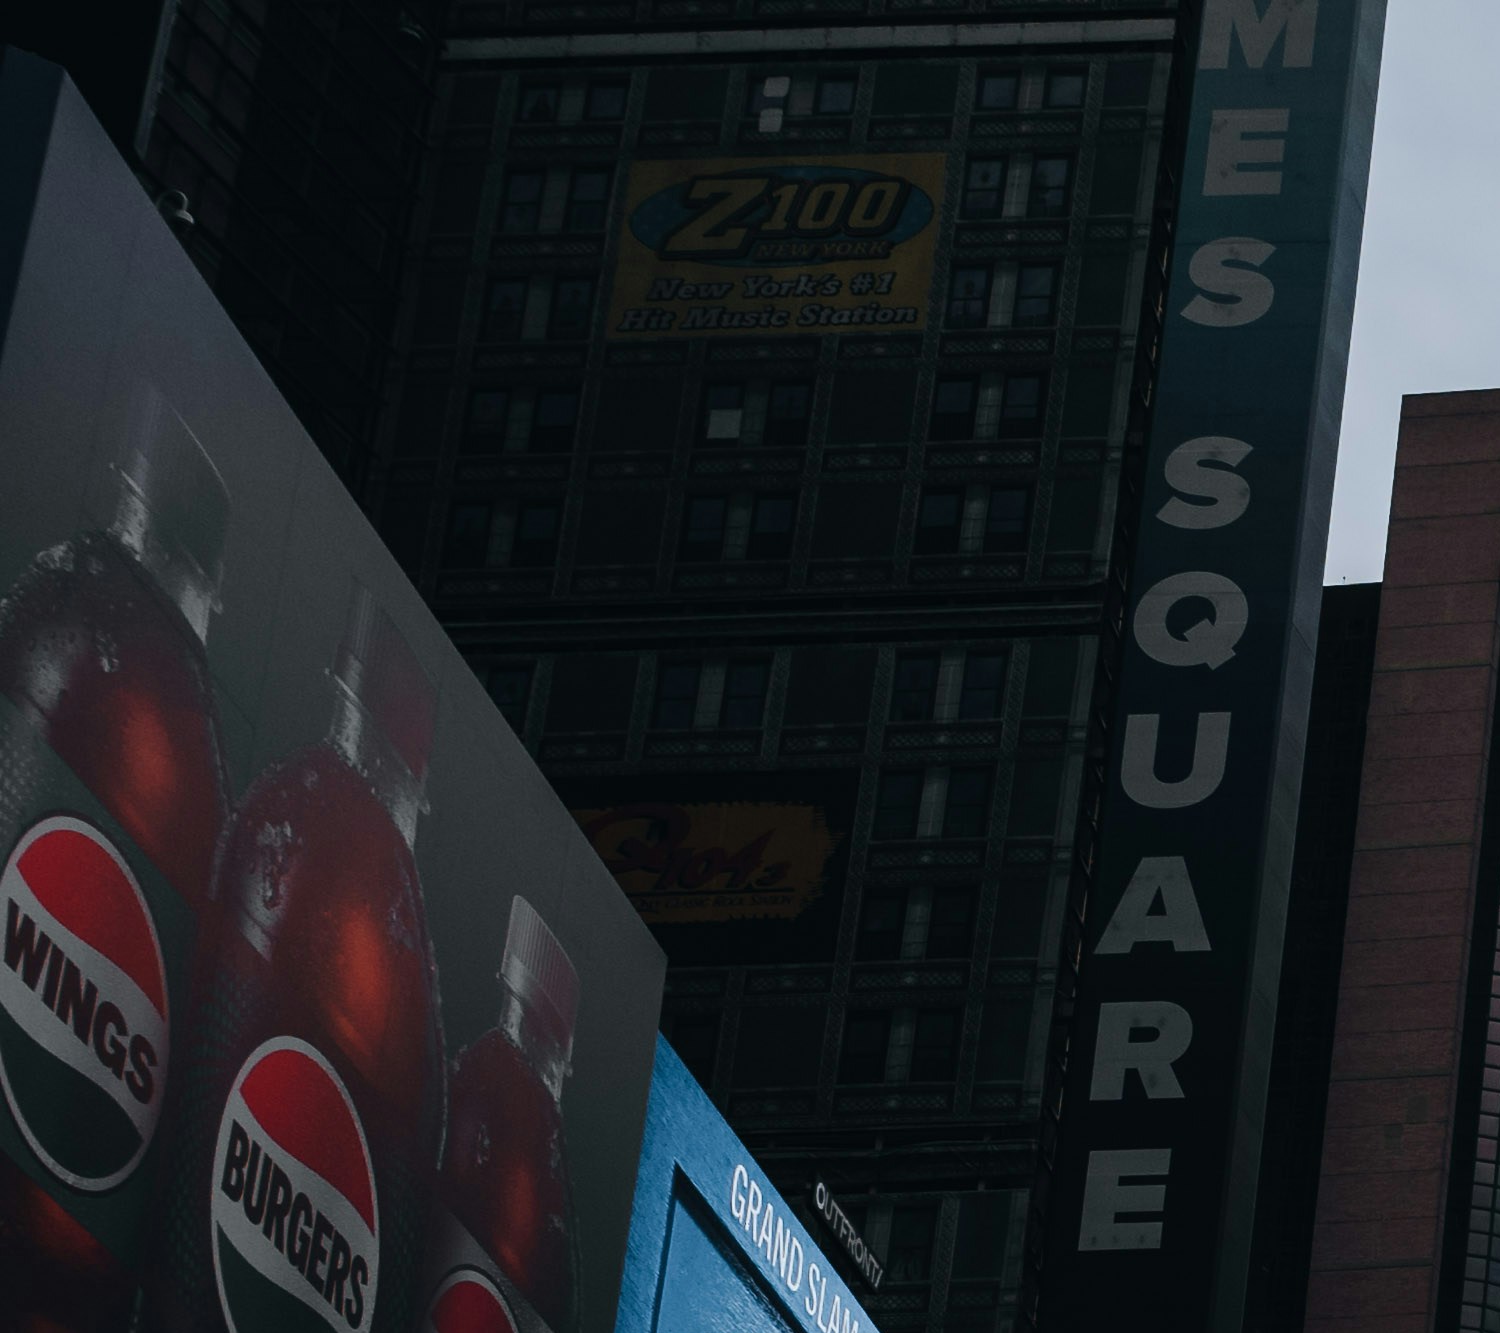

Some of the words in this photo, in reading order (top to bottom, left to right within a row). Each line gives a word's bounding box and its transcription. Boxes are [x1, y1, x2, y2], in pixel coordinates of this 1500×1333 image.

[661, 177, 909, 259] Z100
[757, 242, 808, 258] NEW
[820, 240, 890, 258] YORK
[617, 309, 676, 332] Hit
[680, 307, 790, 330] Music
[797, 303, 918, 326] Station
[648, 278, 732, 301] New
[742, 274, 843, 298] York's
[850, 272, 896, 295] #1
[1079, 435, 1254, 1252] SQUARE
[3, 899, 156, 1104] WINGS
[221, 1121, 368, 1329] BURGERS
[730, 1164, 803, 1292] GRAND
